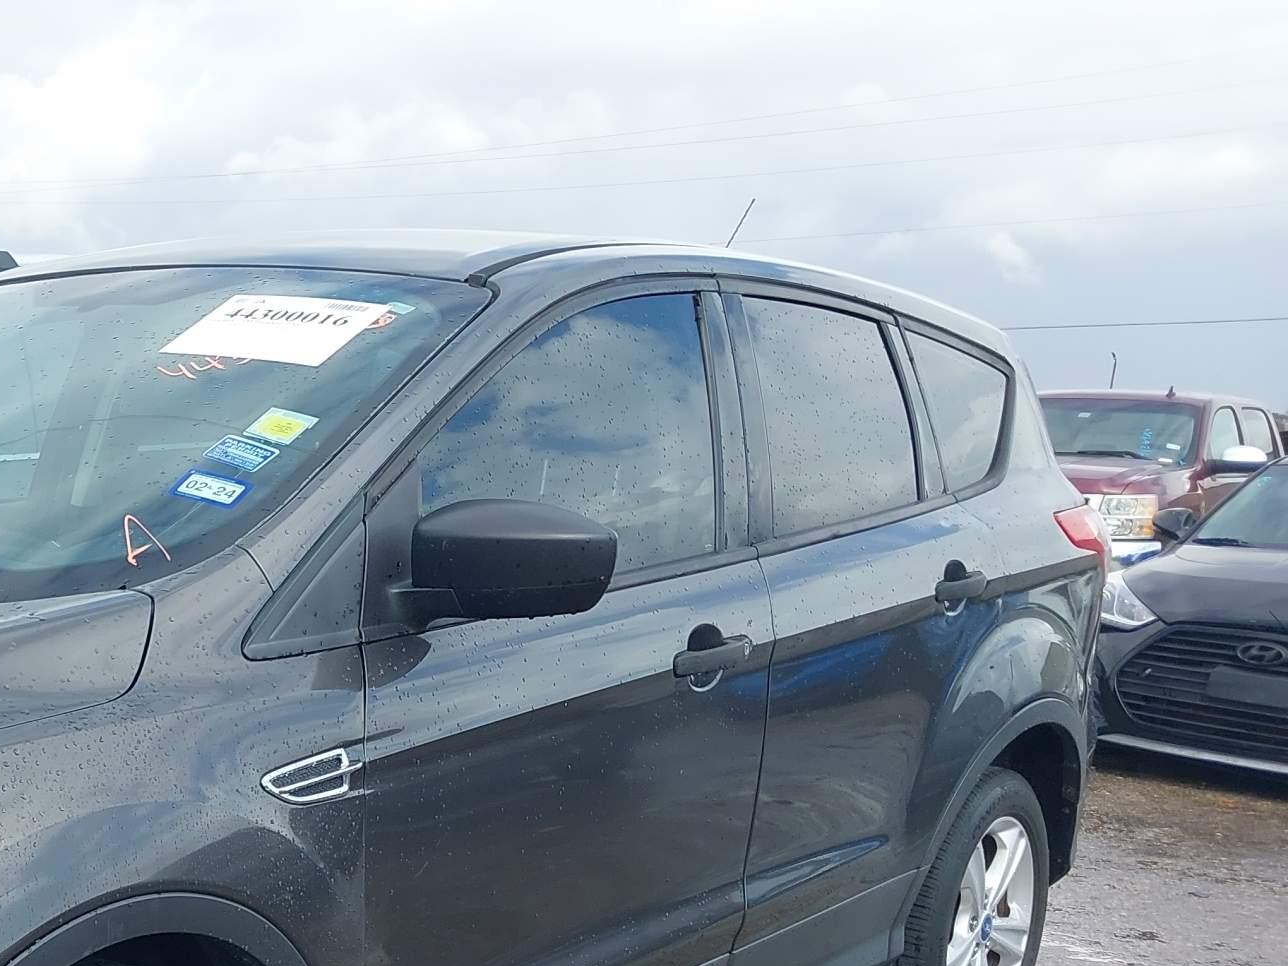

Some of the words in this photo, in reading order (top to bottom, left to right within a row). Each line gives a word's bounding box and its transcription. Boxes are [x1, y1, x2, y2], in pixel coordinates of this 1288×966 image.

[225, 307, 350, 327] 44300016
[185, 479, 209, 492] 02
[212, 486, 237, 499] 24
[124, 514, 172, 566] A
